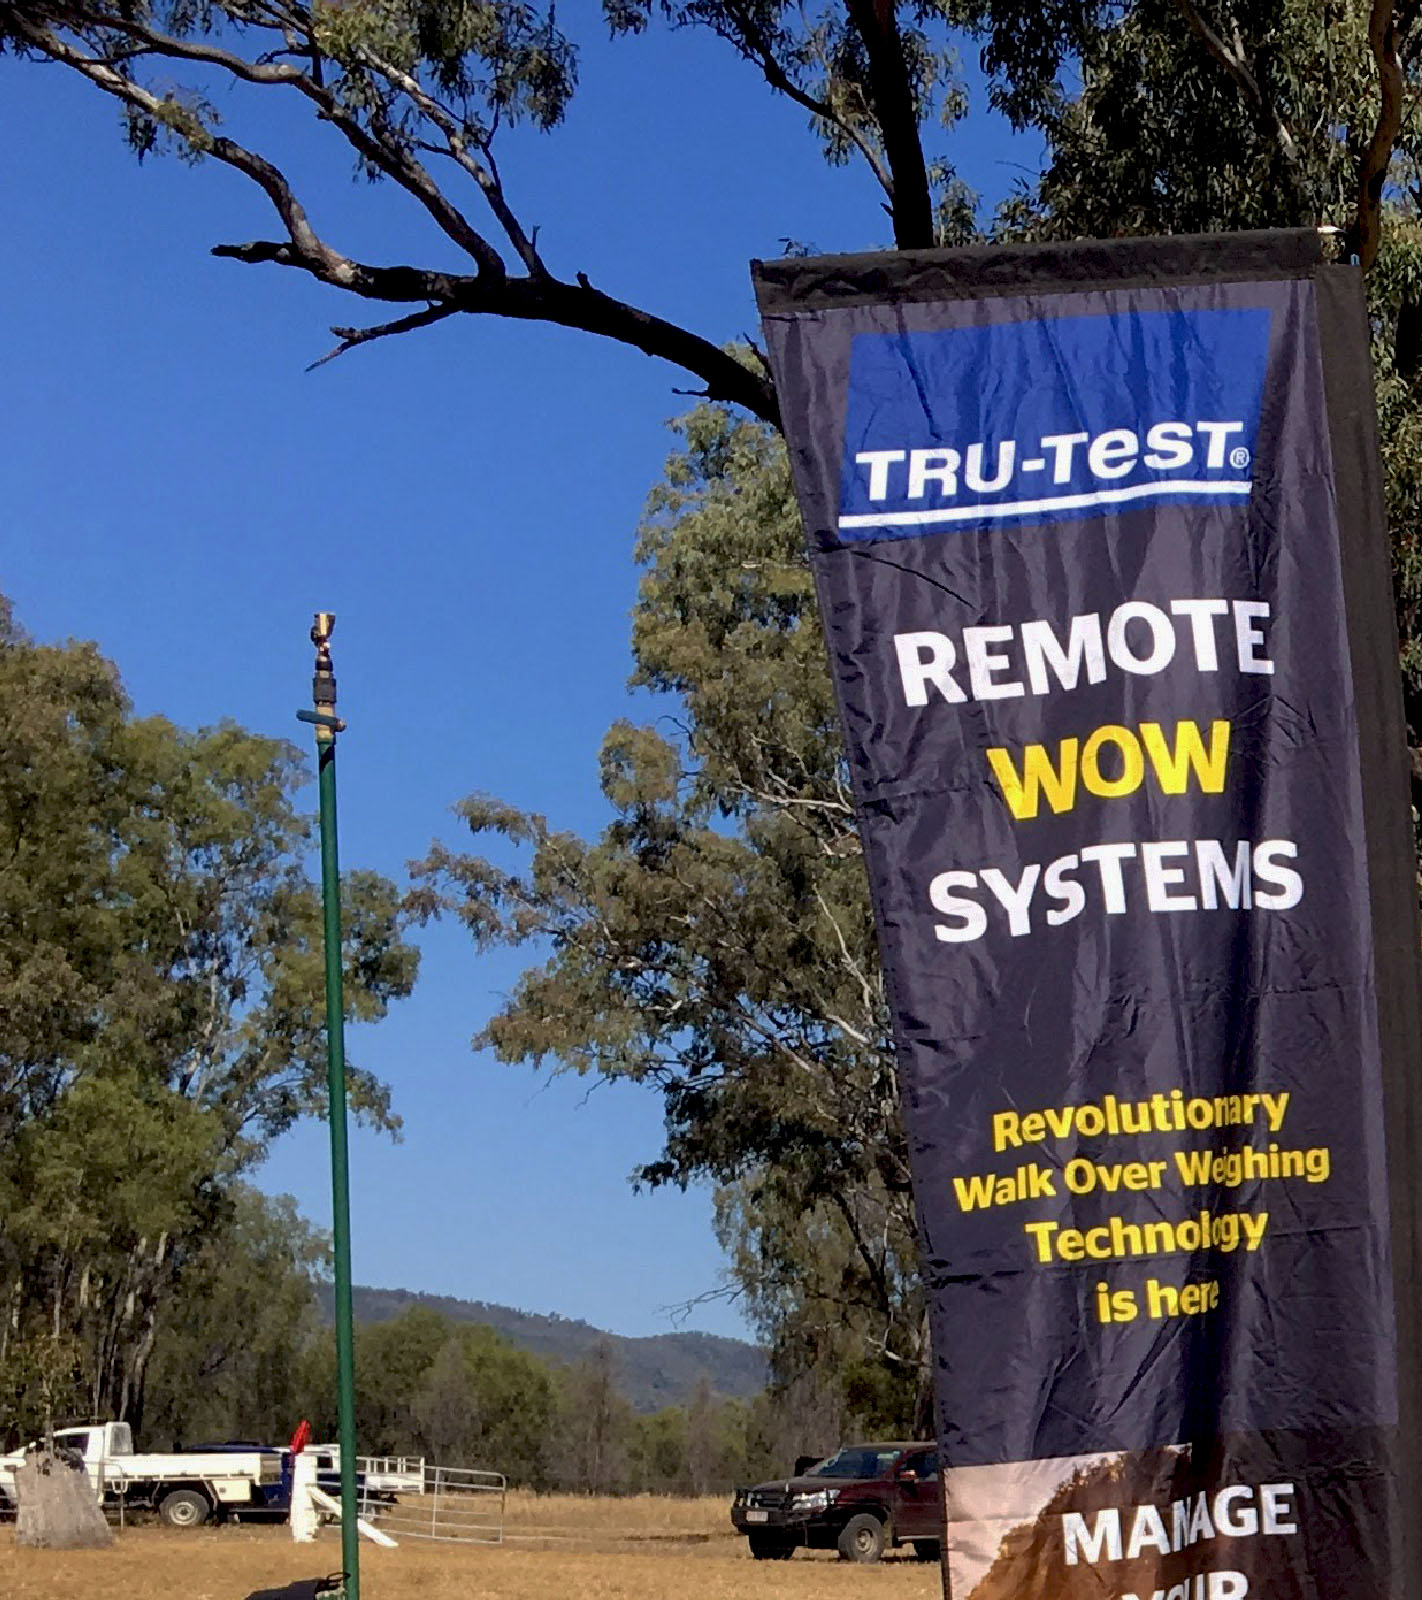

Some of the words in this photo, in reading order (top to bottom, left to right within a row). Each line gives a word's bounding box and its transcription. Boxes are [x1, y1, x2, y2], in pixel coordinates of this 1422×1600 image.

[893, 600, 1275, 707] REMOTE
[986, 720, 1230, 820] WOW
[928, 839, 1303, 944] SYSTEMS
[993, 1089, 1290, 1152] Revolutionary
[953, 1163, 1057, 1212] Walk
[1064, 1157, 1167, 1194] Over
[1174, 1144, 1330, 1187] Weighing
[1025, 1210, 1270, 1263] Technology
[1097, 1281, 1139, 1323] is
[1061, 1482, 1298, 1566] MANAGE
